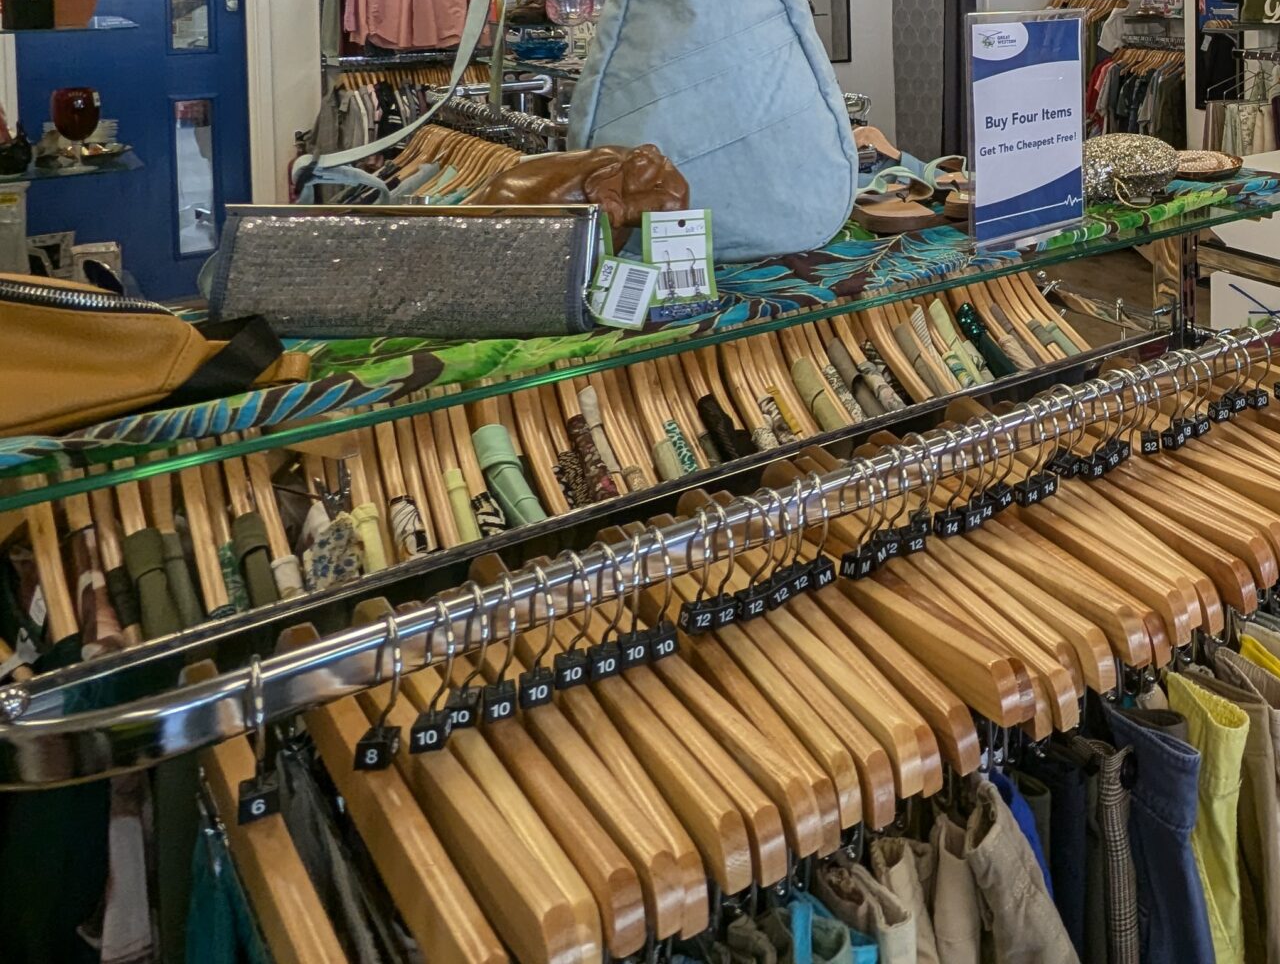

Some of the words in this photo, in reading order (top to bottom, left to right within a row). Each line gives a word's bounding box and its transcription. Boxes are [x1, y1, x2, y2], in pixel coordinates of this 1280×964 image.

[985, 115, 1008, 131] Buy
[1011, 111, 1038, 126] Four
[1041, 106, 1072, 121] Items
[980, 146, 996, 157] Get
[998, 142, 1014, 154] The
[1016, 135, 1054, 152] Cheapest
[1056, 131, 1077, 144] Free!
[1235, 398, 1246, 409] 20
[1257, 395, 1268, 406] 20
[1218, 410, 1229, 420] 20
[1198, 422, 1209, 433] 20
[1144, 441, 1157, 451] 32
[1109, 454, 1119, 466] 16
[1093, 464, 1103, 476] 16
[1044, 481, 1054, 493] 14
[1000, 492, 1012, 506] 14
[1027, 490, 1038, 502] 14
[982, 505, 993, 517] 14
[946, 521, 959, 534] 14
[969, 514, 981, 527] 14
[909, 538, 924, 551] 12
[877, 548, 887, 563] M
[844, 561, 855, 575] M
[861, 560, 871, 574] M
[793, 575, 809, 590] 12
[819, 570, 832, 585] M
[773, 587, 790, 603] 12
[749, 600, 764, 615] 12
[696, 613, 711, 627] 12
[719, 608, 734, 623] 12
[626, 645, 645, 661] 10
[656, 639, 675, 656] 10
[596, 658, 616, 674] 10
[563, 666, 582, 682] 10
[528, 685, 548, 701] 10
[451, 710, 470, 724] 10
[490, 702, 511, 718] 10
[416, 729, 438, 747] 10
[365, 749, 378, 764] 8
[251, 798, 266, 815] 6
